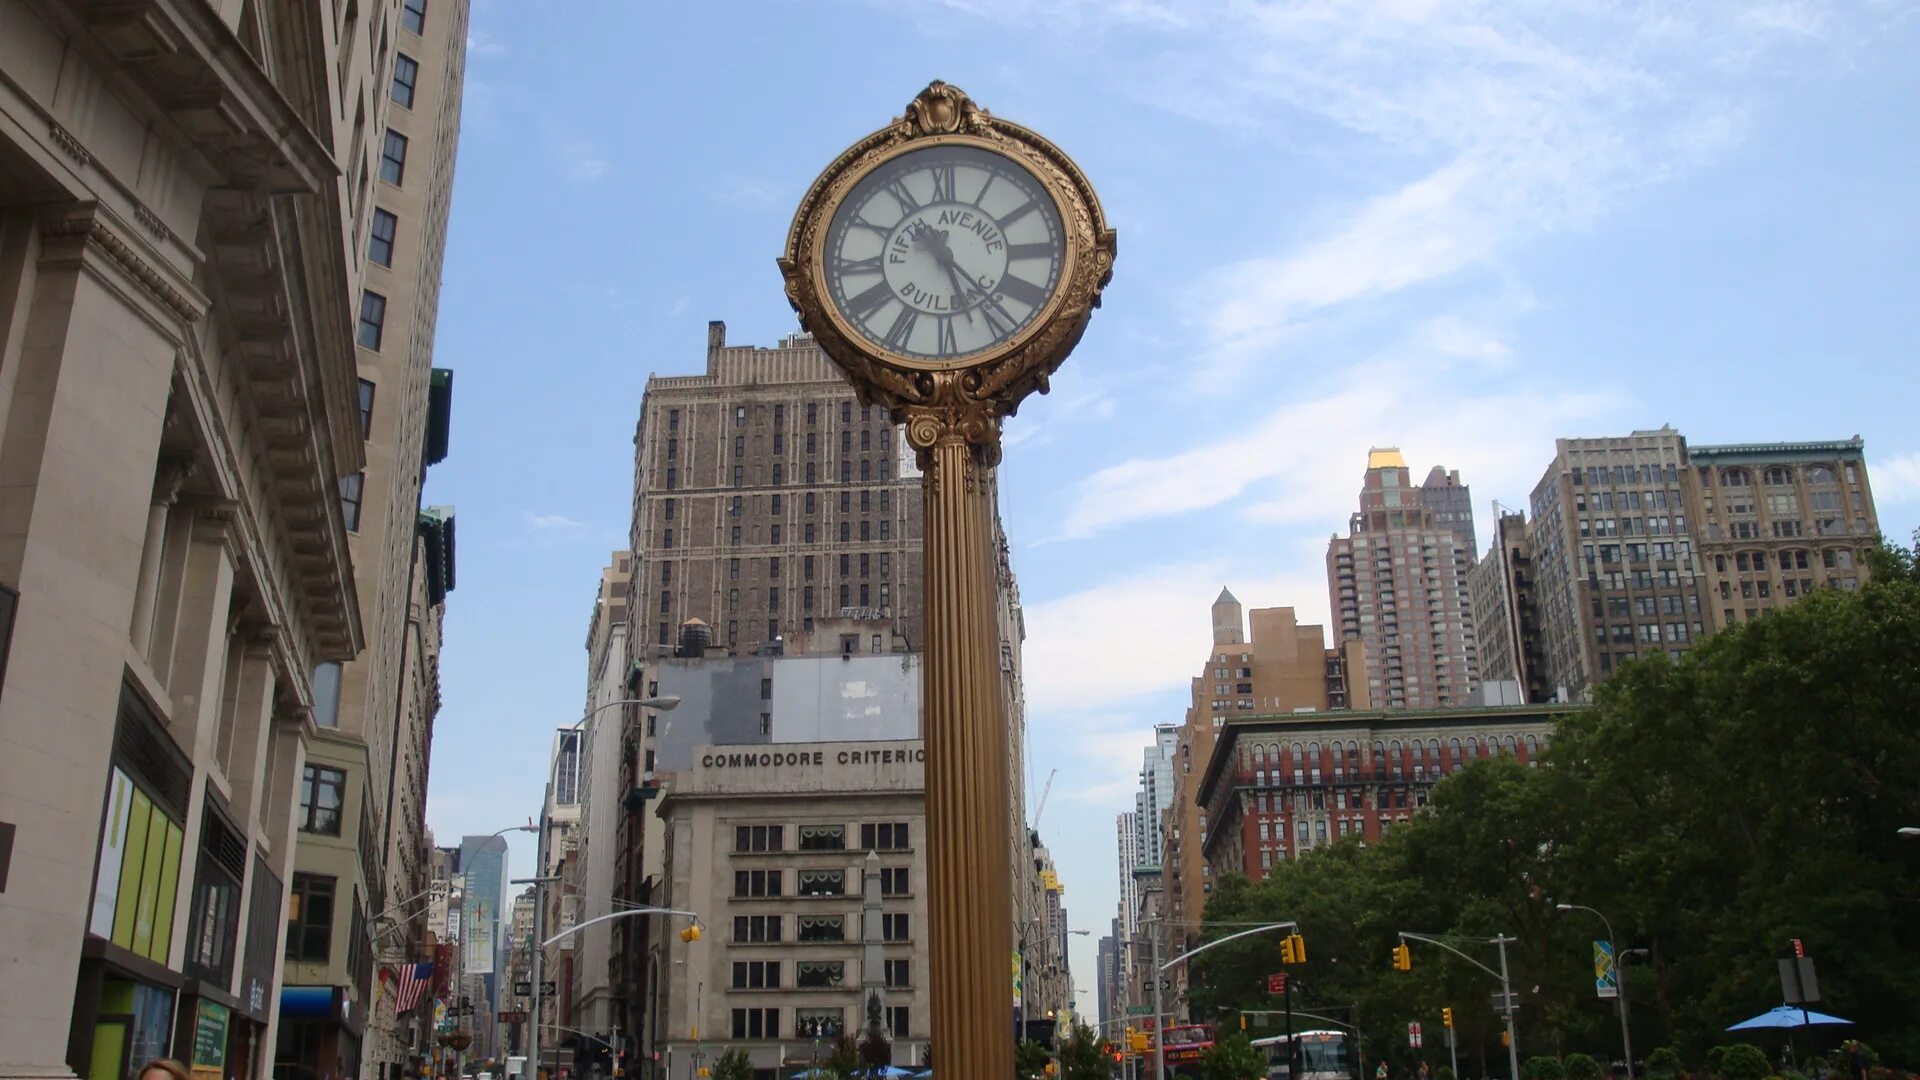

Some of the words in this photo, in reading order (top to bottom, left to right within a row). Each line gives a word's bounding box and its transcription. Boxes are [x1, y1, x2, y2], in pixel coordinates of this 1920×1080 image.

[890, 217, 927, 265] FIFTH
[938, 210, 1003, 255] AVENUE
[900, 275, 995, 311] BUILG
[702, 752, 824, 768] COMMODORE
[837, 749, 925, 765] CRITERIO
